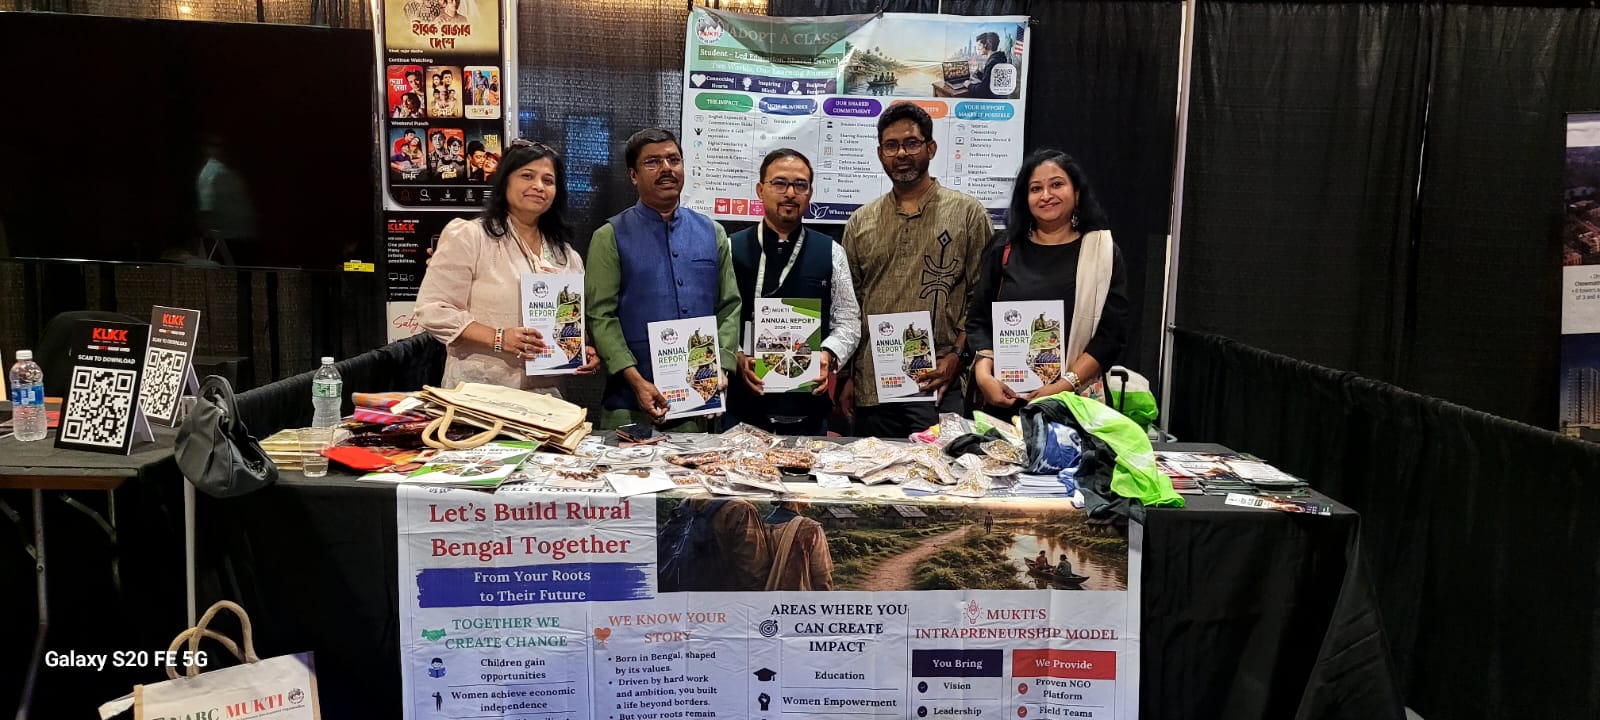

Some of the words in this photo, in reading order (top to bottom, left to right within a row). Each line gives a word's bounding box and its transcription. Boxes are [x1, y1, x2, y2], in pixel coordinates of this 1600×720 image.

[441, 24, 471, 36] রাজার
[730, 27, 776, 44] ADOPT
[780, 33, 790, 45] A
[794, 32, 839, 45] CLASS
[430, 38, 456, 49] দেশে
[700, 48, 728, 57] Student
[814, 56, 840, 65] Growth
[758, 80, 782, 88] Inspiring
[529, 310, 556, 318] REPORT
[1000, 329, 1030, 337] ANNUAL
[876, 338, 902, 346] ANNUAL
[658, 347, 687, 356] ANNUAL
[78, 354, 94, 362] SCAN
[102, 356, 136, 364] DOWNLOAD
[658, 354, 688, 364] REPORT
[428, 502, 487, 523] Let's
[494, 501, 559, 522] Build
[566, 500, 632, 521] Rural
[431, 536, 513, 562] Bengal
[520, 535, 631, 561] Together
[474, 571, 510, 584] From
[514, 570, 548, 583] Your
[552, 570, 591, 582] Roots
[480, 592, 494, 602] to
[497, 590, 536, 602] Their
[539, 590, 586, 601] Future
[771, 604, 816, 615] AREAS
[820, 604, 873, 615] WHERE
[877, 604, 908, 616] YOU
[987, 608, 1047, 620] MUKTI'S
[452, 617, 533, 630] TOGETHER
[536, 616, 560, 628] WE
[608, 615, 632, 627] WE
[636, 612, 682, 626] KNOW
[686, 612, 727, 624] YOUR
[794, 622, 825, 634] CAN
[828, 622, 884, 634] CREATE
[916, 627, 1062, 640] INTRAPRENEURSHIP
[1066, 628, 1118, 640] MODEL
[445, 637, 502, 650] CREATE
[505, 636, 568, 648] CHANGE
[644, 631, 692, 644] STORY
[809, 641, 866, 652] IMPACT
[480, 658, 522, 667] Children
[524, 657, 546, 668] gain
[615, 654, 638, 662] Born
[640, 654, 649, 662] in
[651, 652, 682, 663] Bengal,
[685, 651, 716, 661] shaped
[616, 666, 626, 675] by
[628, 666, 640, 674] its
[642, 665, 672, 673] values.
[932, 659, 952, 668] You
[955, 659, 983, 670] Bring
[1035, 658, 1050, 668] We
[1053, 659, 1093, 670] Provide
[480, 671, 546, 682] opportunities
[618, 678, 648, 686] Driven
[650, 676, 662, 685] by
[664, 676, 684, 684] hard
[686, 674, 709, 682] work
[815, 671, 865, 680] Education
[943, 682, 971, 690] Vision
[1036, 678, 1067, 688] Proven
[1070, 680, 1092, 688] NGO
[452, 690, 489, 700] Women
[491, 689, 527, 698] achieve
[530, 688, 576, 697] economic
[616, 690, 632, 698] and
[634, 688, 677, 698] ambition,
[678, 686, 694, 696] you
[697, 686, 718, 694] built
[1043, 690, 1083, 700] Platform
[226, 693, 284, 718] MUKTI
[480, 700, 548, 713] independence
[624, 701, 638, 709] life
[640, 700, 672, 710] beyond
[674, 698, 710, 706] borders.
[783, 696, 820, 706] Women
[824, 697, 898, 708] Empowerment
[638, 712, 658, 720] your
[660, 710, 682, 718] roots
[685, 709, 716, 718] remain
[934, 706, 982, 718] Leadership
[1039, 706, 1061, 716] Field
[1063, 708, 1093, 718] Teams
